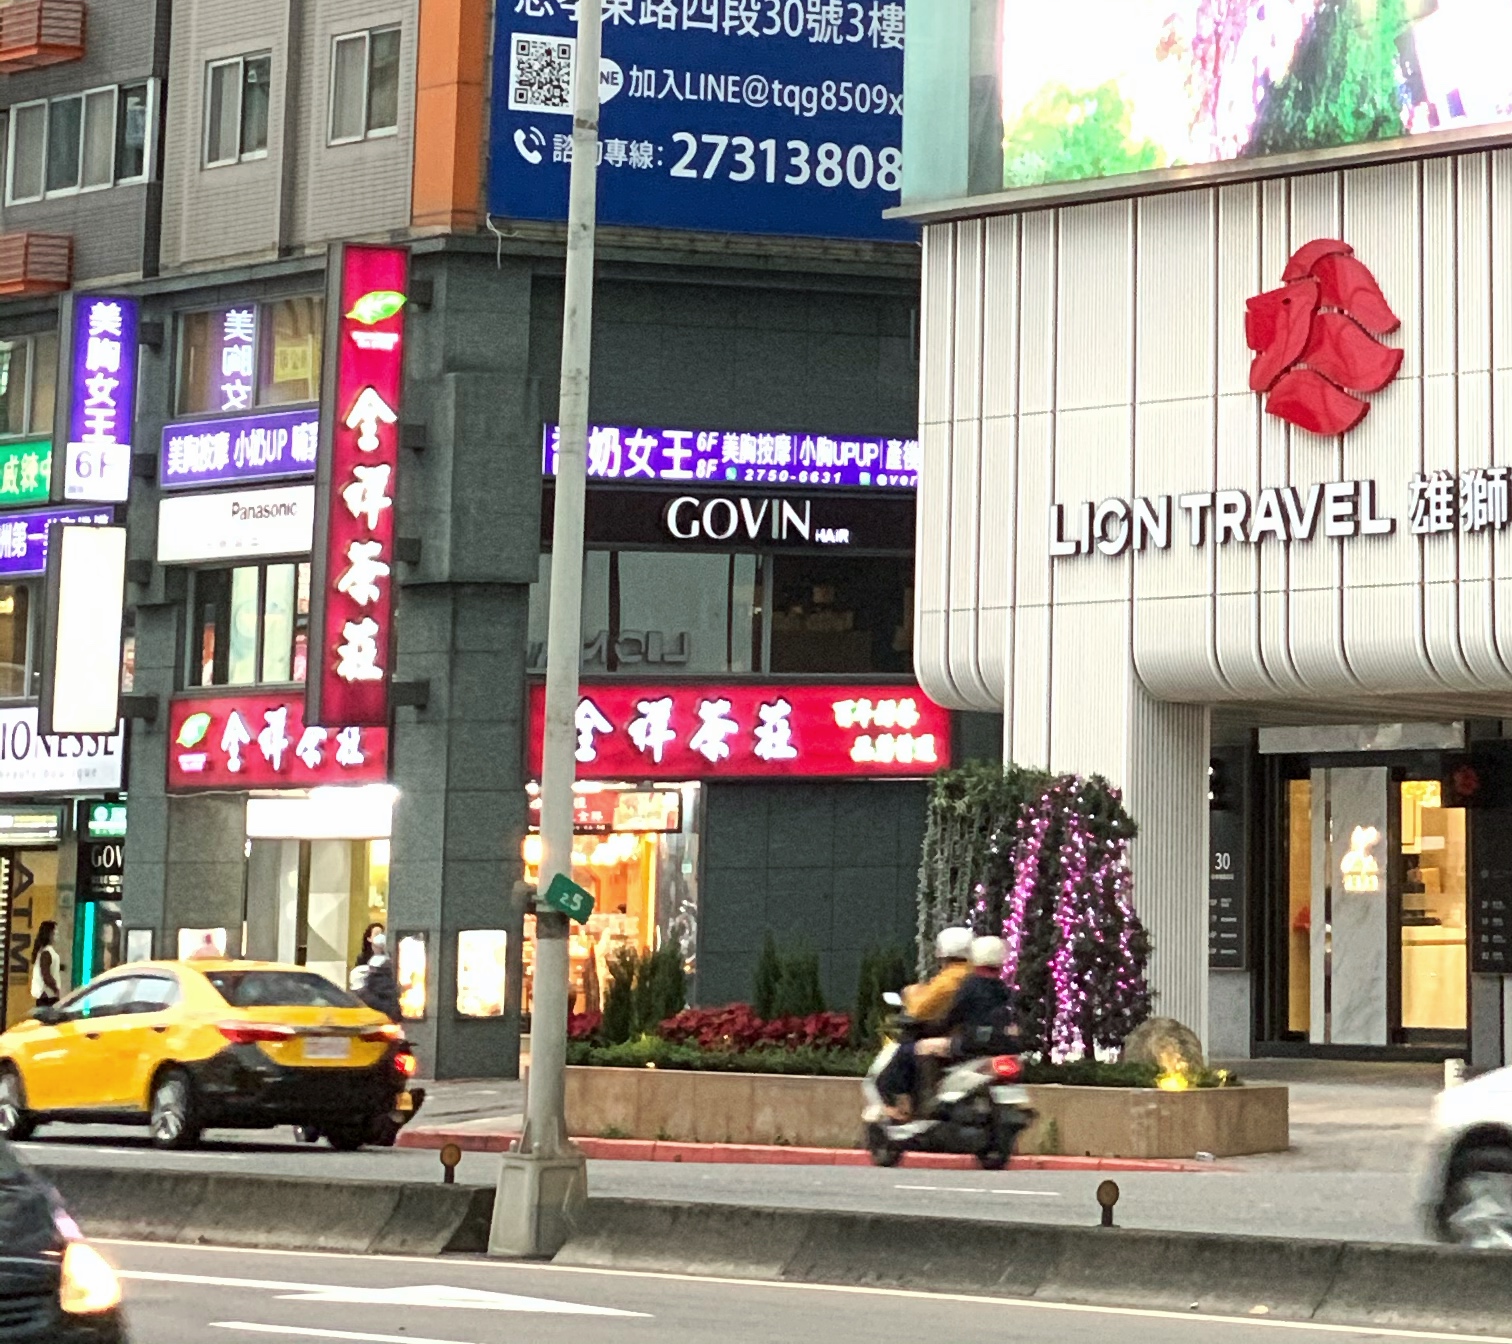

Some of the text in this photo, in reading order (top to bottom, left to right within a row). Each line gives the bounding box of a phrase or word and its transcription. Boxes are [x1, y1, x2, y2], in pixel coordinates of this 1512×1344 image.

[669, 131, 902, 192] 27313808
[82, 301, 122, 444] 美胸女王
[551, 425, 694, 480] 奶女王
[743, 468, 842, 484] 2750-6631
[231, 501, 298, 521] Panasonic
[667, 495, 812, 540] GOVIN
[1048, 494, 1172, 558] LION
[1179, 478, 1396, 547] TRAVEL
[1214, 852, 1231, 871] 30
[10, 862, 35, 974] ATM
